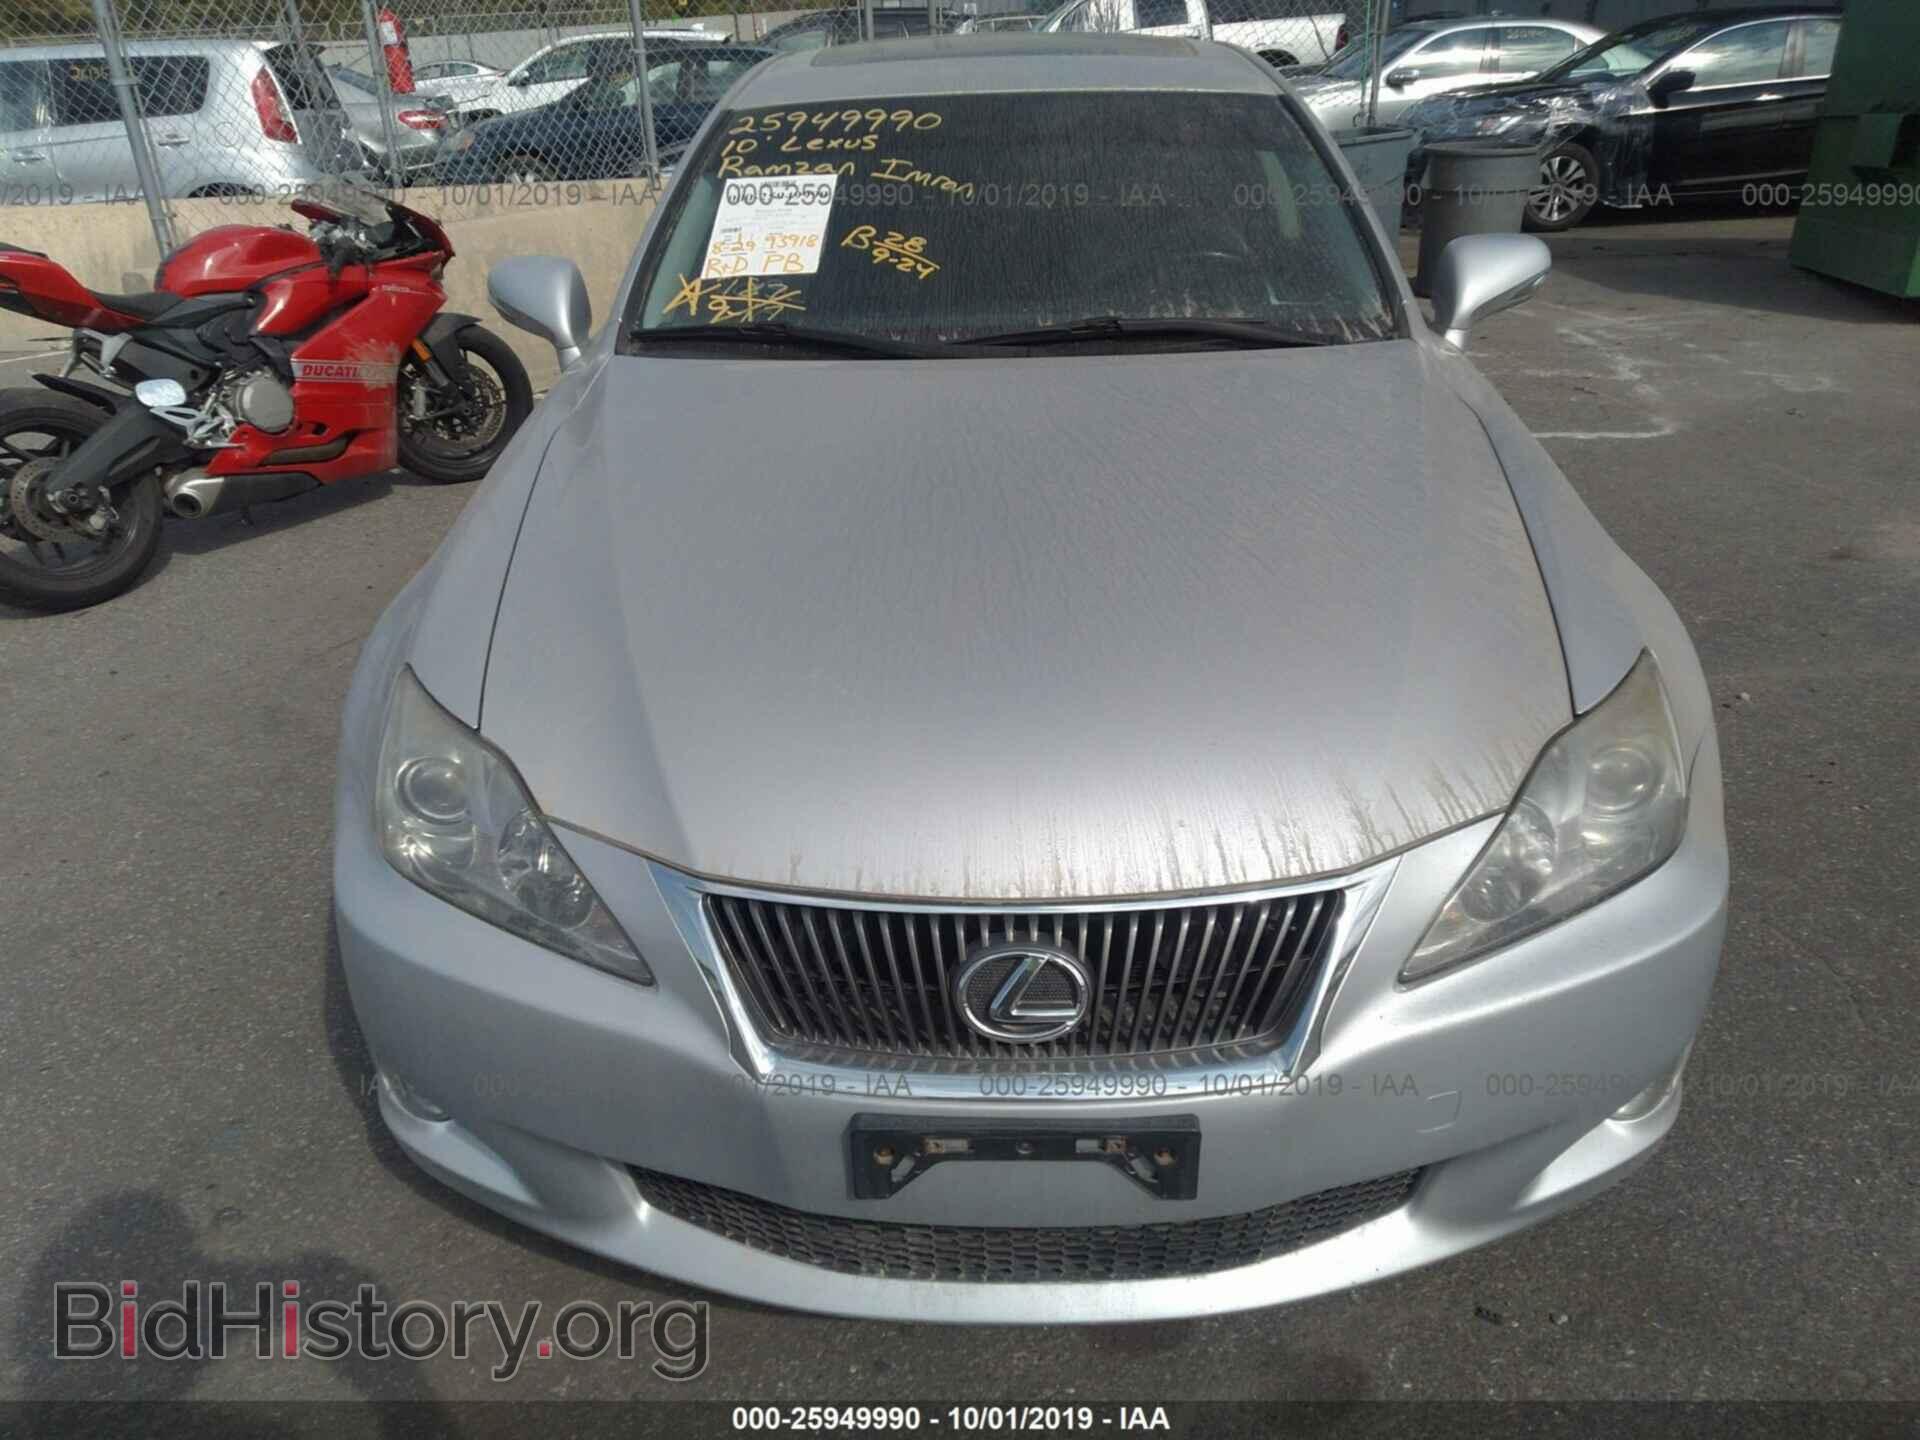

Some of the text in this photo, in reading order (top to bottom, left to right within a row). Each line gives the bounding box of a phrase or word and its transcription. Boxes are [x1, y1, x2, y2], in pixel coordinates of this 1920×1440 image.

[729, 109, 942, 135] 25949990
[781, 134, 879, 151] Lexus
[302, 364, 360, 378] DUCATI
